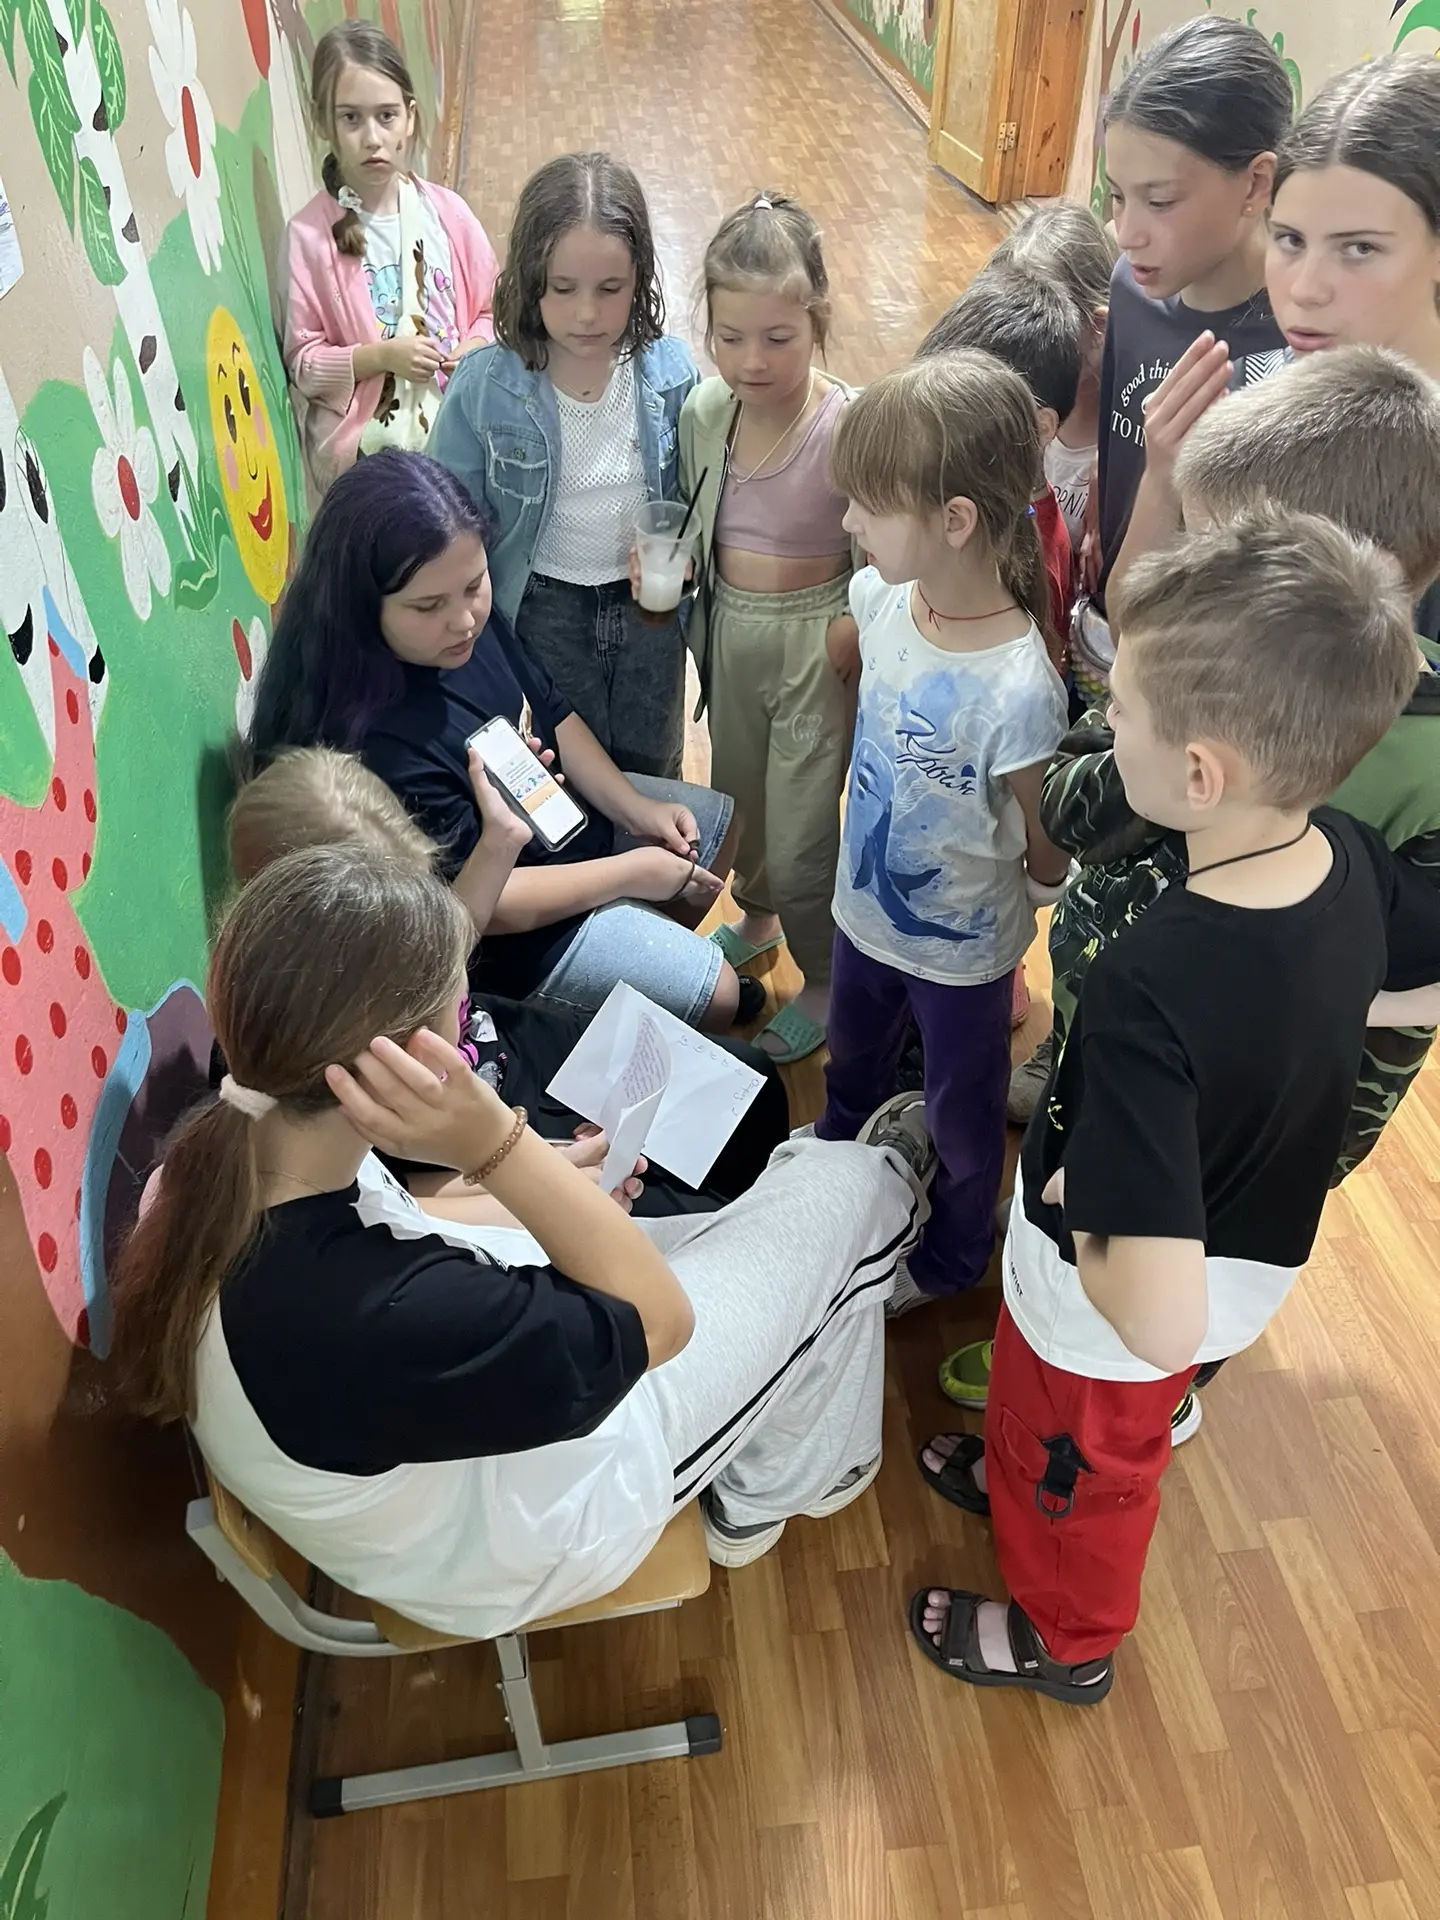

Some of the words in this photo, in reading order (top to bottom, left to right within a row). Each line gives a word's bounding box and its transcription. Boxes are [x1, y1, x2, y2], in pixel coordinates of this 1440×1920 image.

[1120, 363, 1145, 408] good
[1149, 358, 1172, 380] thi
[1112, 410, 1132, 438] TO
